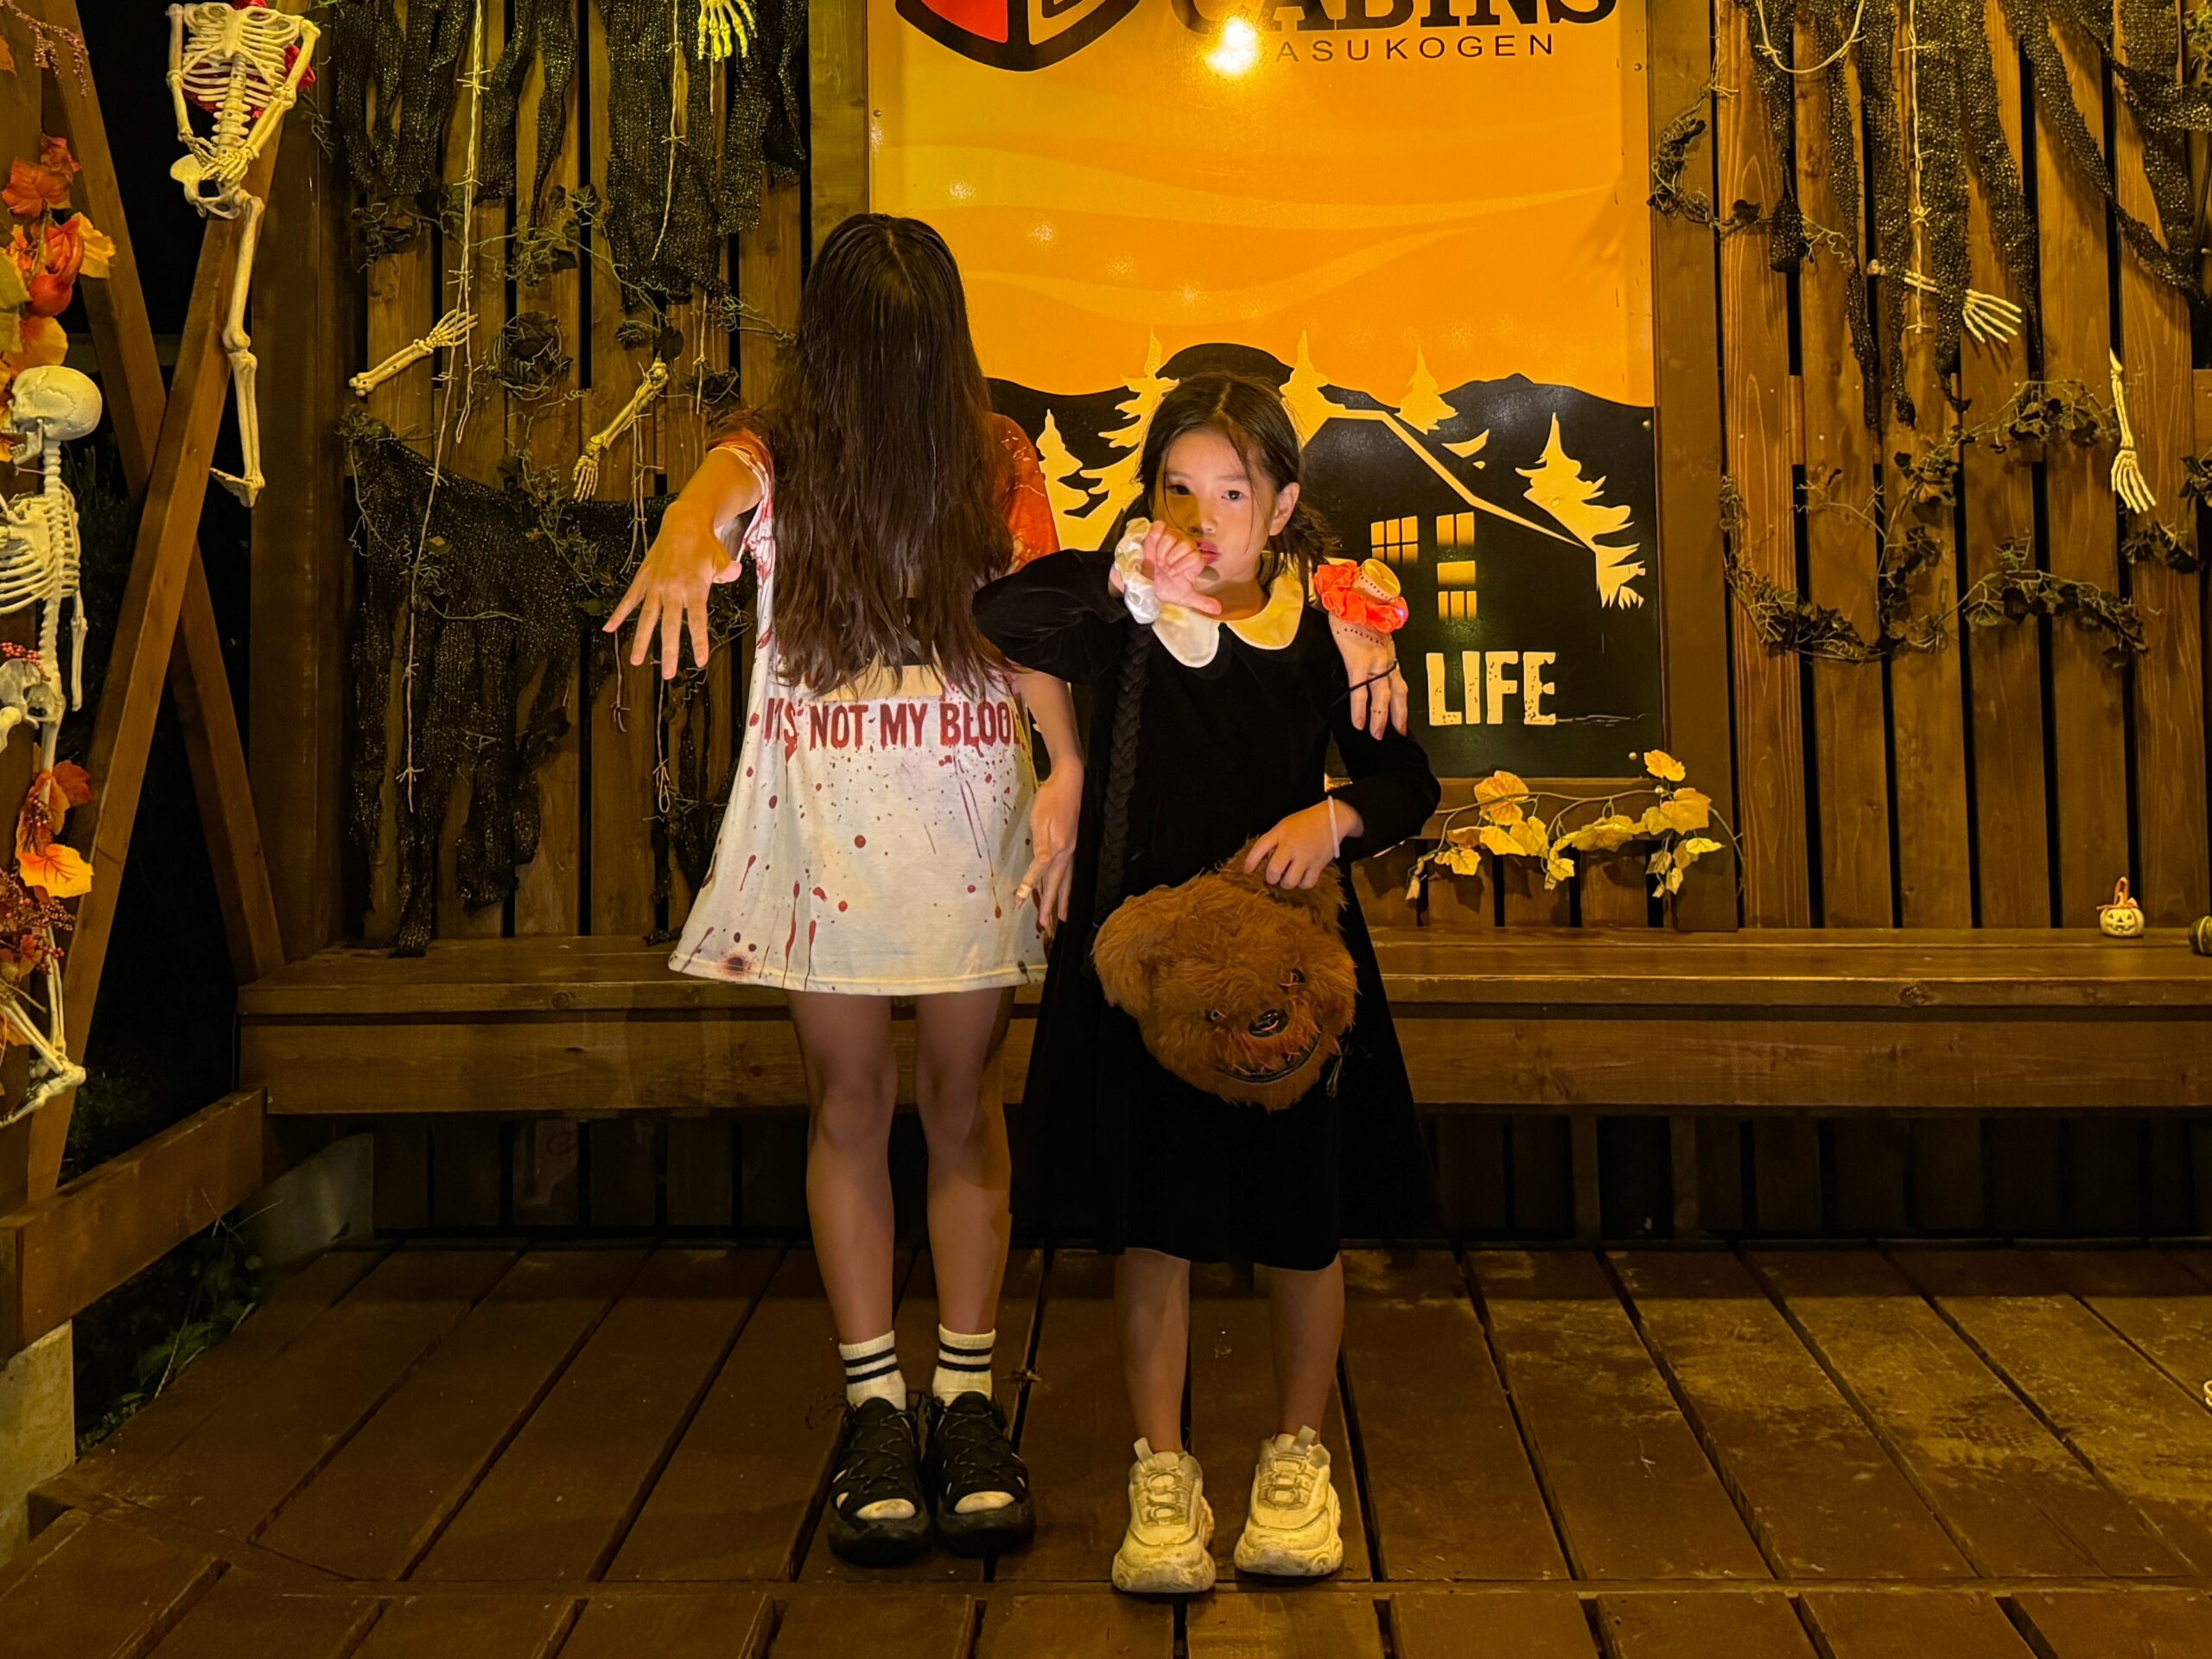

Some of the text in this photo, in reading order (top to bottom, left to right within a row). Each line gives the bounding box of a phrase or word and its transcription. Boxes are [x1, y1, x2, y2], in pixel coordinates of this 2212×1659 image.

[1426, 651, 1556, 726] LIFE
[809, 702, 869, 750] NOT
[880, 702, 929, 749] MY
